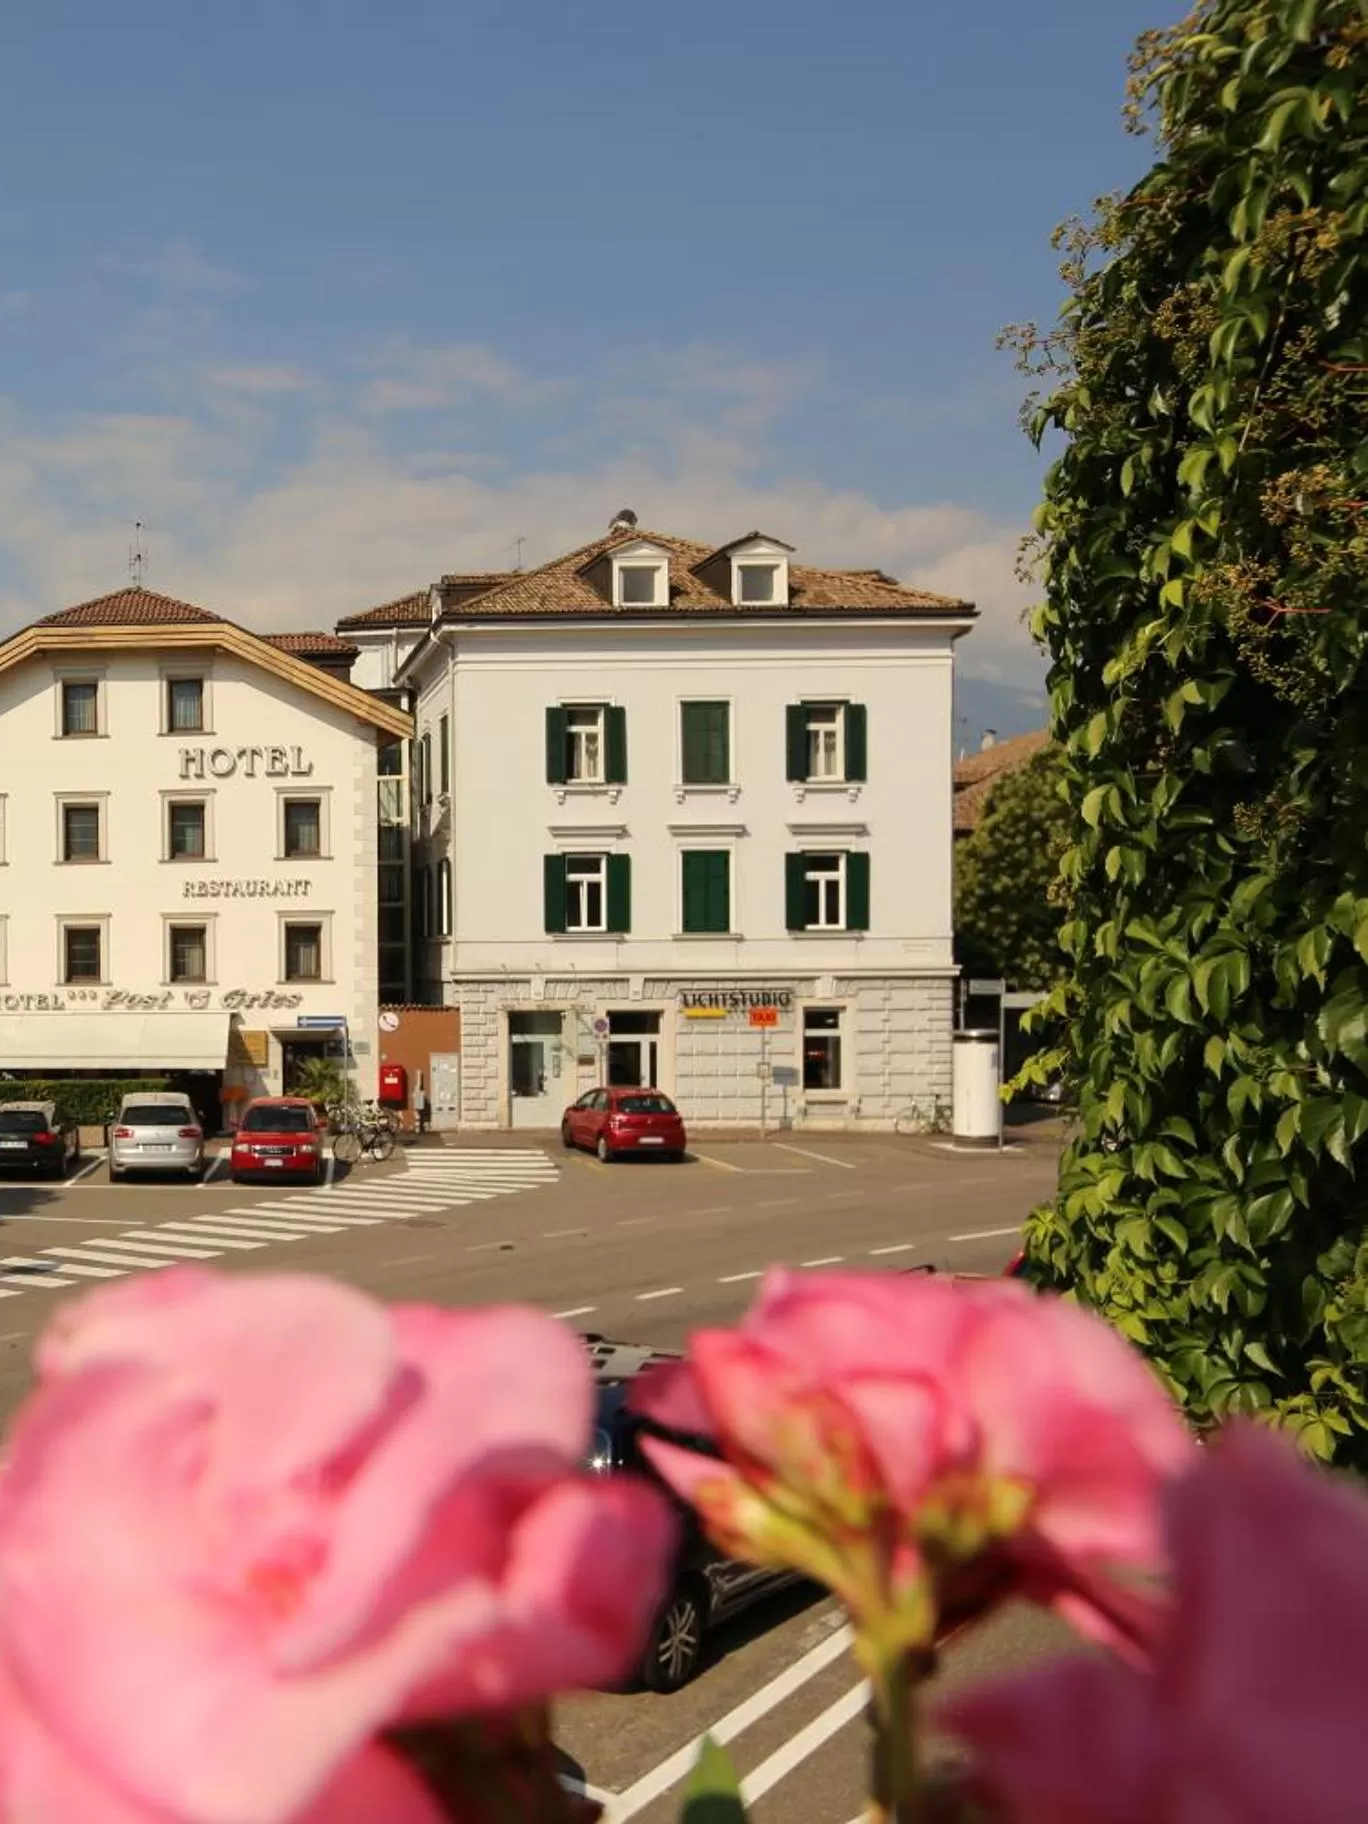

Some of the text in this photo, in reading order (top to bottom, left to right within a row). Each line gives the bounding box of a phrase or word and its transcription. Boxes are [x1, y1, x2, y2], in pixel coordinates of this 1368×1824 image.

[179, 746, 314, 780] HOTEL
[182, 879, 312, 898] RESTAURANT
[100, 989, 174, 1011] Post
[683, 991, 790, 1008] LICHTSTUDIO
